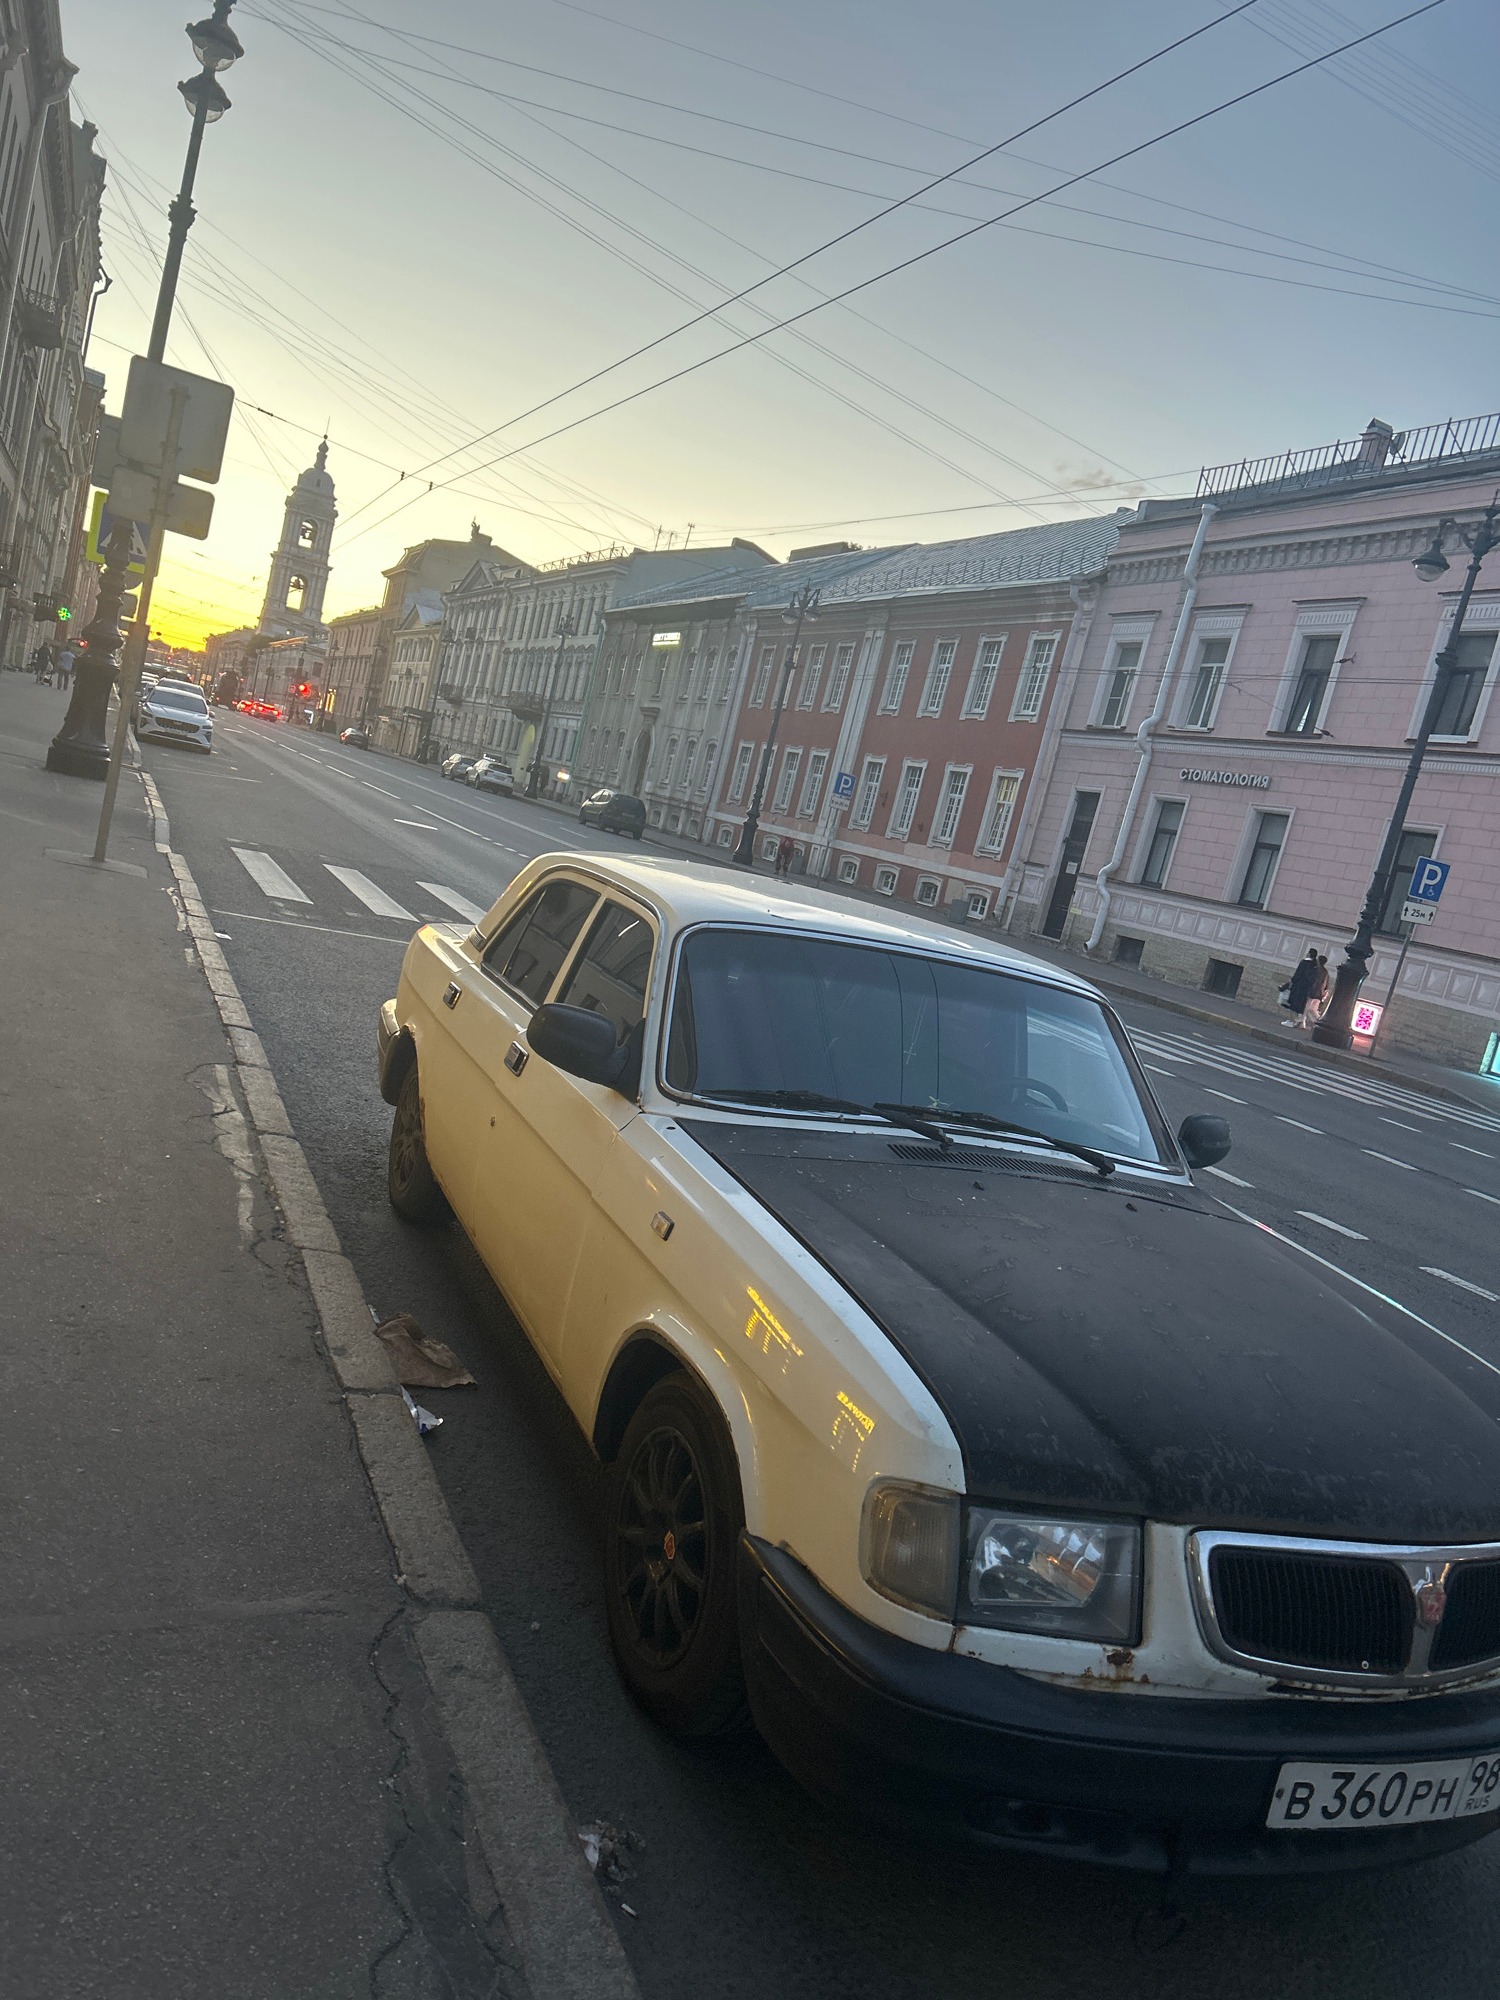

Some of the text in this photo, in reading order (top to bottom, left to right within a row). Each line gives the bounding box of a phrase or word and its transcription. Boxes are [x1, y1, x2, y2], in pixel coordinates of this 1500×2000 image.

[838, 775, 852, 793] P
[1180, 768, 1270, 788] СТОМАТОЛОГИЯ
[1418, 863, 1443, 894] P
[1469, 1758, 1500, 1796] 98
[1464, 1795, 1490, 1811] RUS
